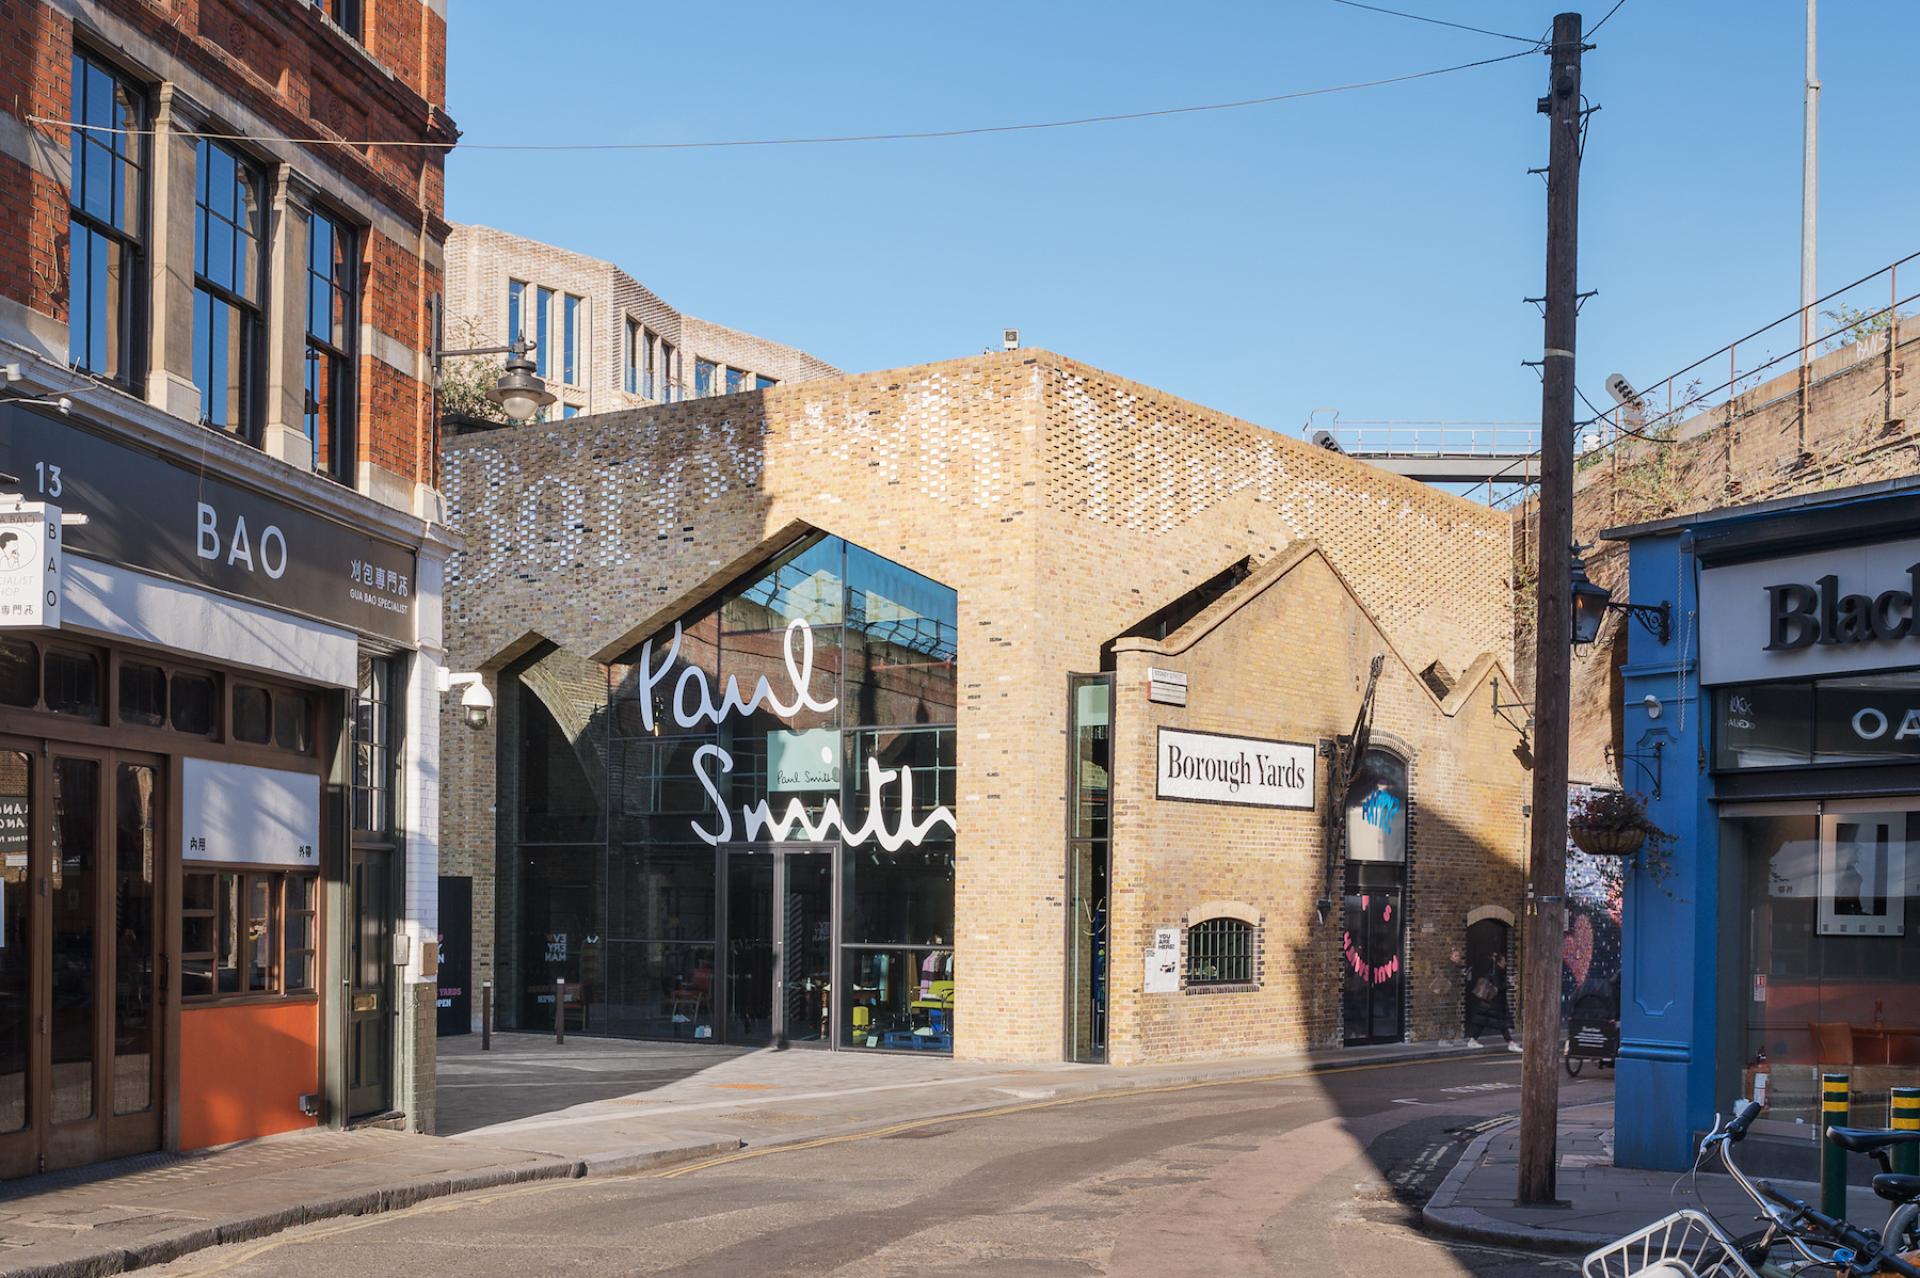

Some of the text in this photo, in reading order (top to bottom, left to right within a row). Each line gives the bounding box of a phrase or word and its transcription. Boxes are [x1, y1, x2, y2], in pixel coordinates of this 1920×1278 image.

[35, 461, 62, 497] 13
[46, 522, 57, 607] BAO
[197, 501, 287, 579] BAO
[350, 588, 408, 615] GUA BAO SPECIALIST
[640, 618, 839, 732] Paul
[777, 769, 800, 785] Paul
[1167, 744, 1305, 794] Borough Yards
[690, 743, 957, 851] Smith
[437, 999, 452, 1007] PEN
